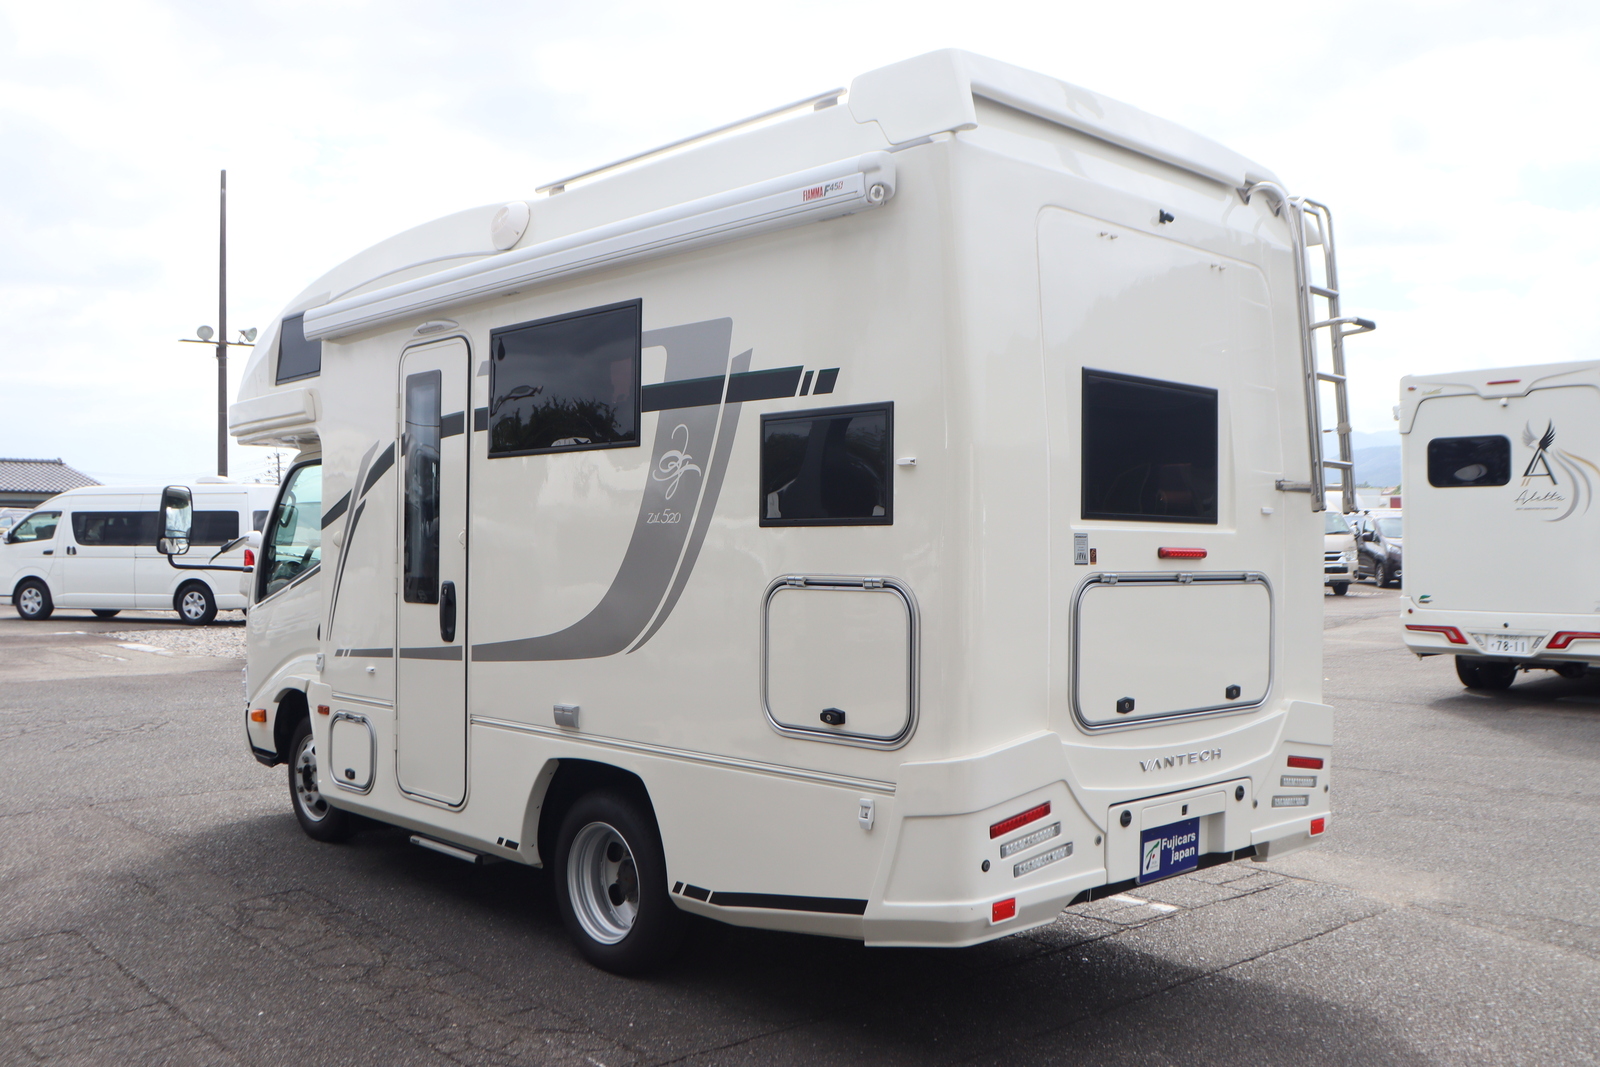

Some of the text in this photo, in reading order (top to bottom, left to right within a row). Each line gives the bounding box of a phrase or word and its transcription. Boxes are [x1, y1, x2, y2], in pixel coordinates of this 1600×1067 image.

[803, 186, 823, 201] FIAMMA
[660, 508, 682, 524] 520
[1139, 747, 1222, 772] VANTECH
[1161, 832, 1196, 850] Fujicars
[1170, 846, 1195, 865] japan
